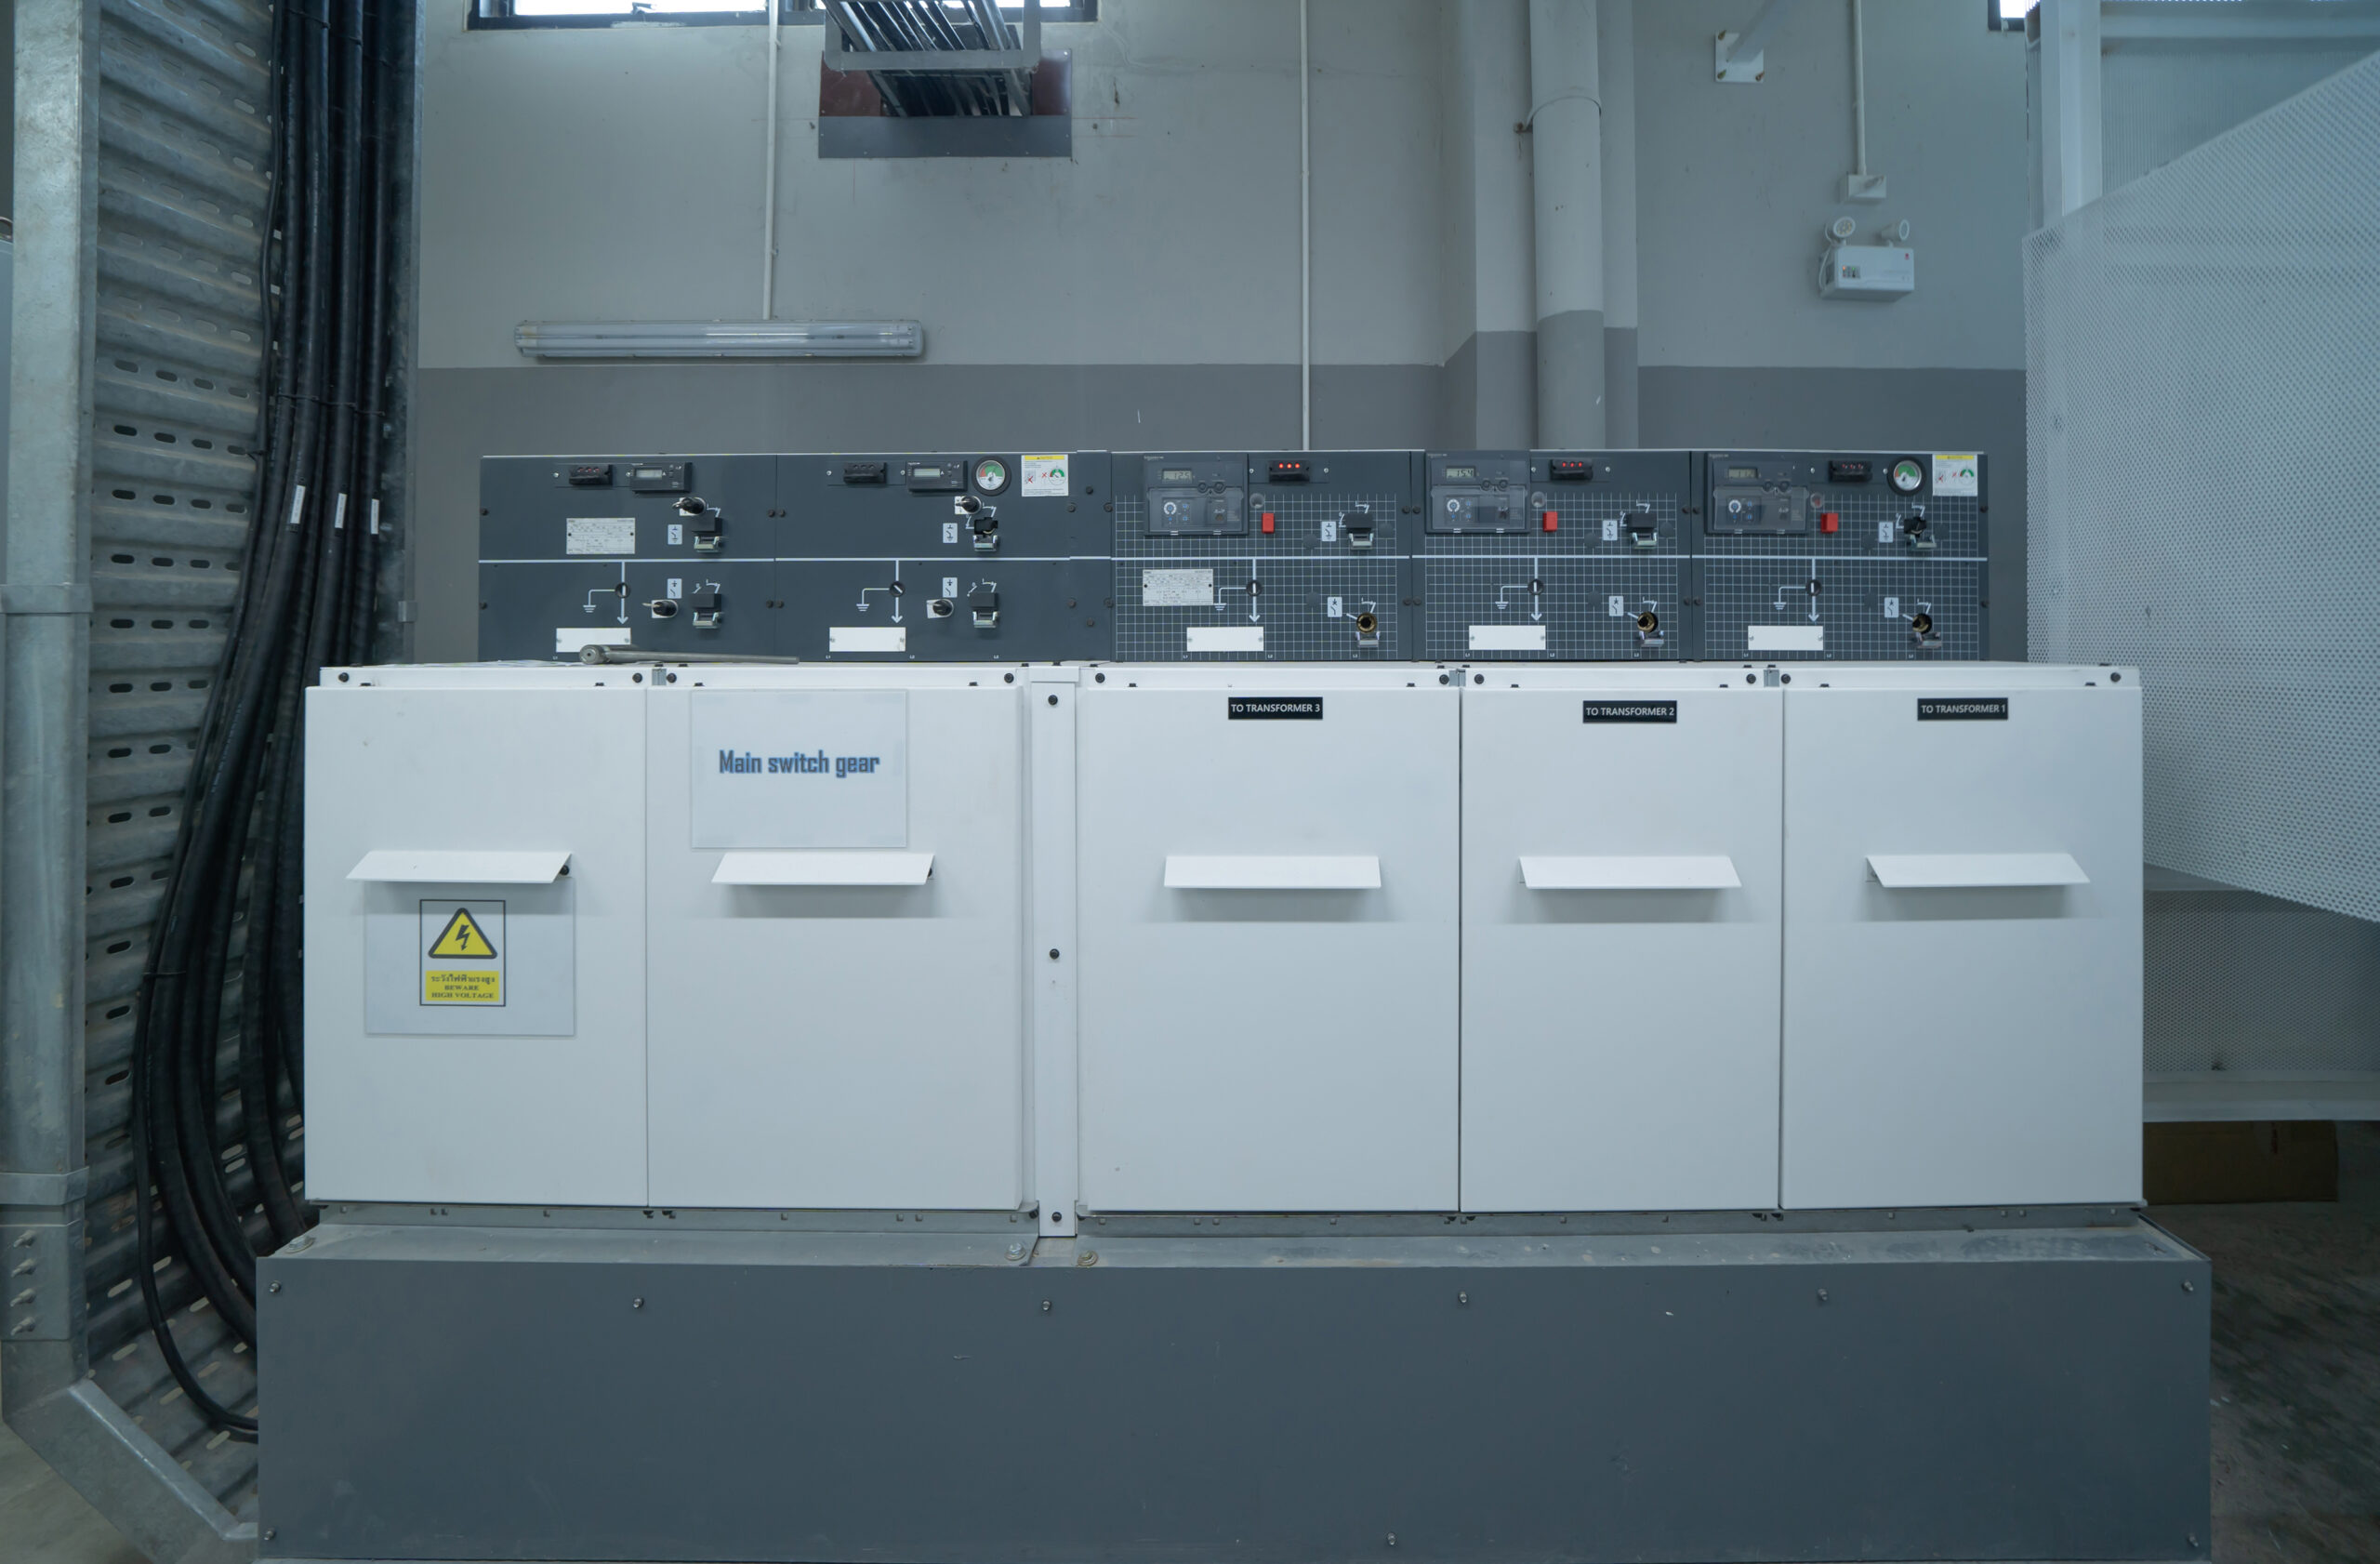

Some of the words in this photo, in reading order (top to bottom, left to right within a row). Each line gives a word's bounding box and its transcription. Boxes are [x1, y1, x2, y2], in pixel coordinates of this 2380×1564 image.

[1231, 704, 1244, 712] TO
[1246, 704, 1313, 712] TRANSFORMER
[1315, 704, 1320, 712] 3
[1586, 707, 1599, 716] TO
[1601, 707, 1667, 716] TRANSFORMER
[1669, 707, 1674, 716] 2
[1921, 705, 1934, 713] TO
[1936, 704, 2000, 713] TRANSFORMER
[719, 749, 762, 774] Main
[768, 749, 829, 774] switch
[835, 756, 880, 778] gear
